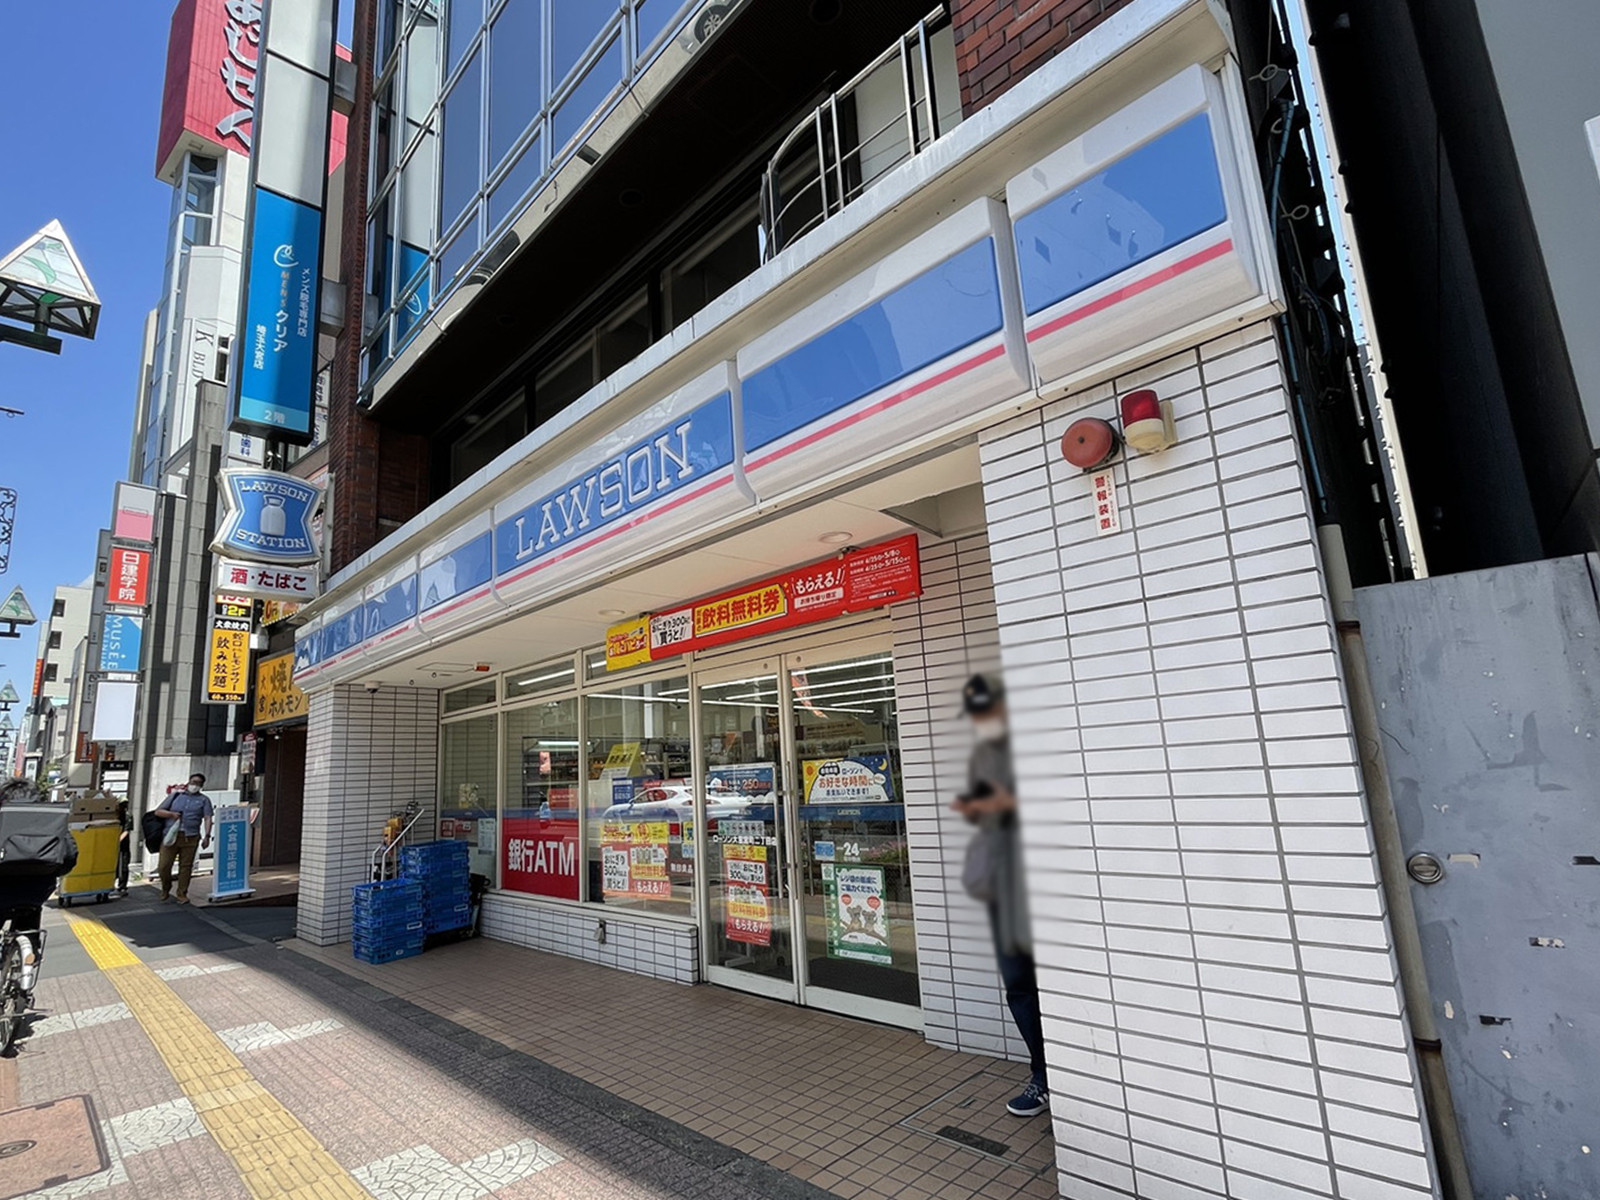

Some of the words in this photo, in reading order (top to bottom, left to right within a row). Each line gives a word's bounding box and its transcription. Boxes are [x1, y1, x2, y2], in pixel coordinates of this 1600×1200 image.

[195, 328, 215, 346] K
[273, 309, 289, 352] クリア
[263, 409, 286, 425] 2階
[240, 480, 308, 502] LAWSON
[514, 419, 694, 561] LAWSON
[236, 528, 306, 548] STATION
[118, 550, 140, 601] 日建学院
[230, 567, 306, 591] 酒・たばこ
[227, 605, 247, 617] 2F
[702, 588, 780, 629] 飲料無料券
[213, 636, 230, 688] 飲み放題
[270, 658, 294, 693] 焼
[268, 694, 303, 718] ホルモン
[508, 838, 575, 876] 銀行ATM
[604, 854, 625, 866] おにぎり
[843, 842, 860, 856] 24
